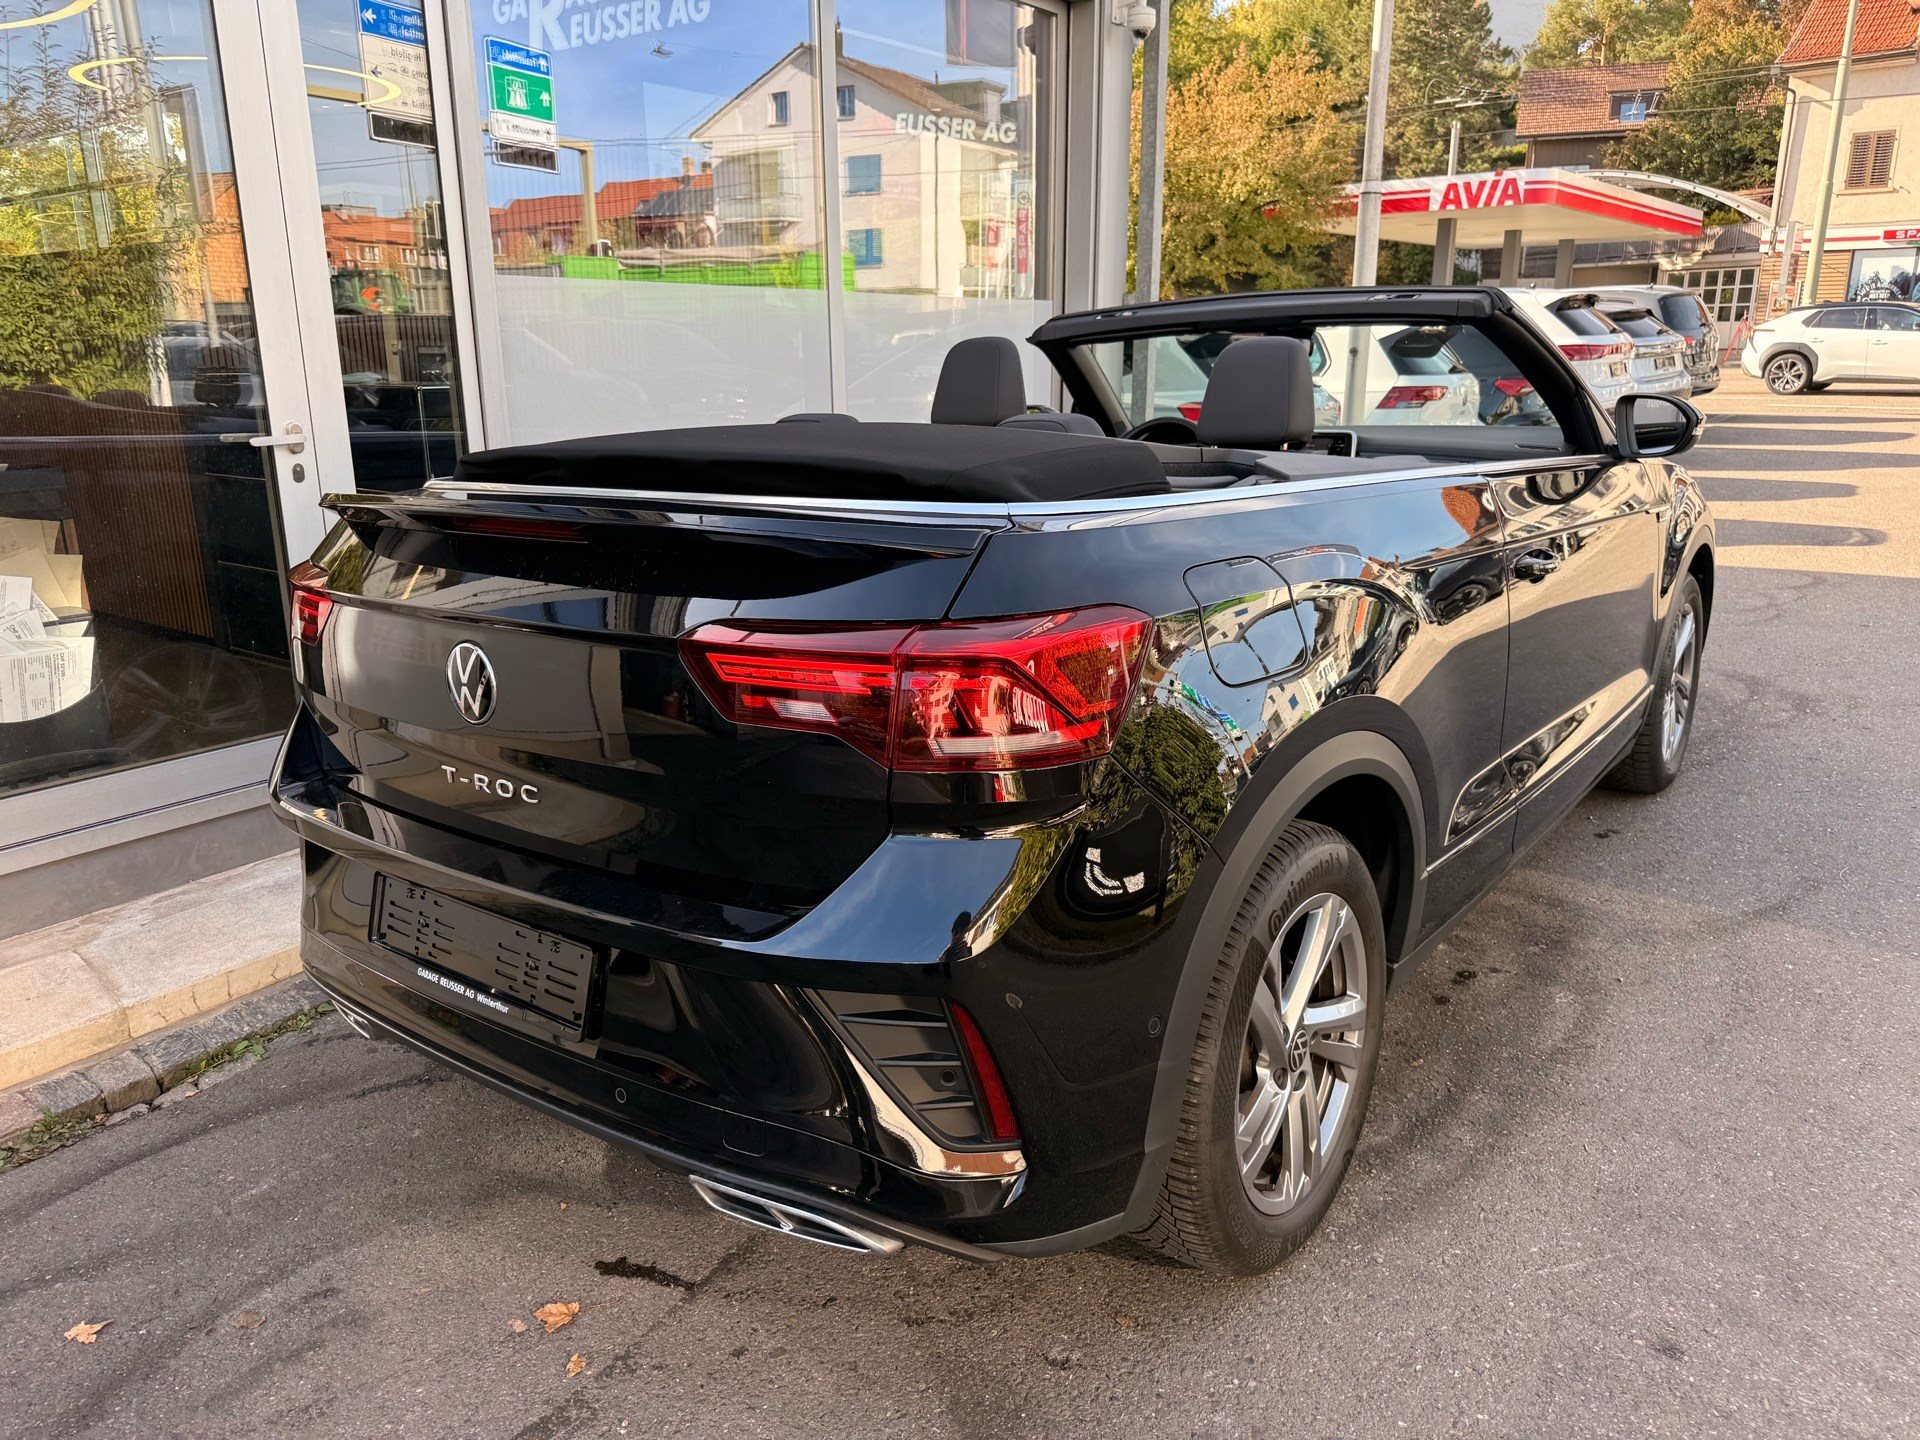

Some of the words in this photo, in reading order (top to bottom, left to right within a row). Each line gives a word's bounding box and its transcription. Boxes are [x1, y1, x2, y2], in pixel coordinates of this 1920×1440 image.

[667, 0, 711, 28] AG
[895, 113, 976, 140] EUSSER
[982, 122, 1018, 144] AG
[1439, 170, 1522, 210] AVIA
[441, 764, 542, 804] T-ROC
[1268, 852, 1334, 943] Continental
[417, 967, 438, 984] GARAGE
[440, 977, 465, 995] REUSSER
[465, 988, 475, 999] AG
[476, 993, 510, 1014] Winterthur
